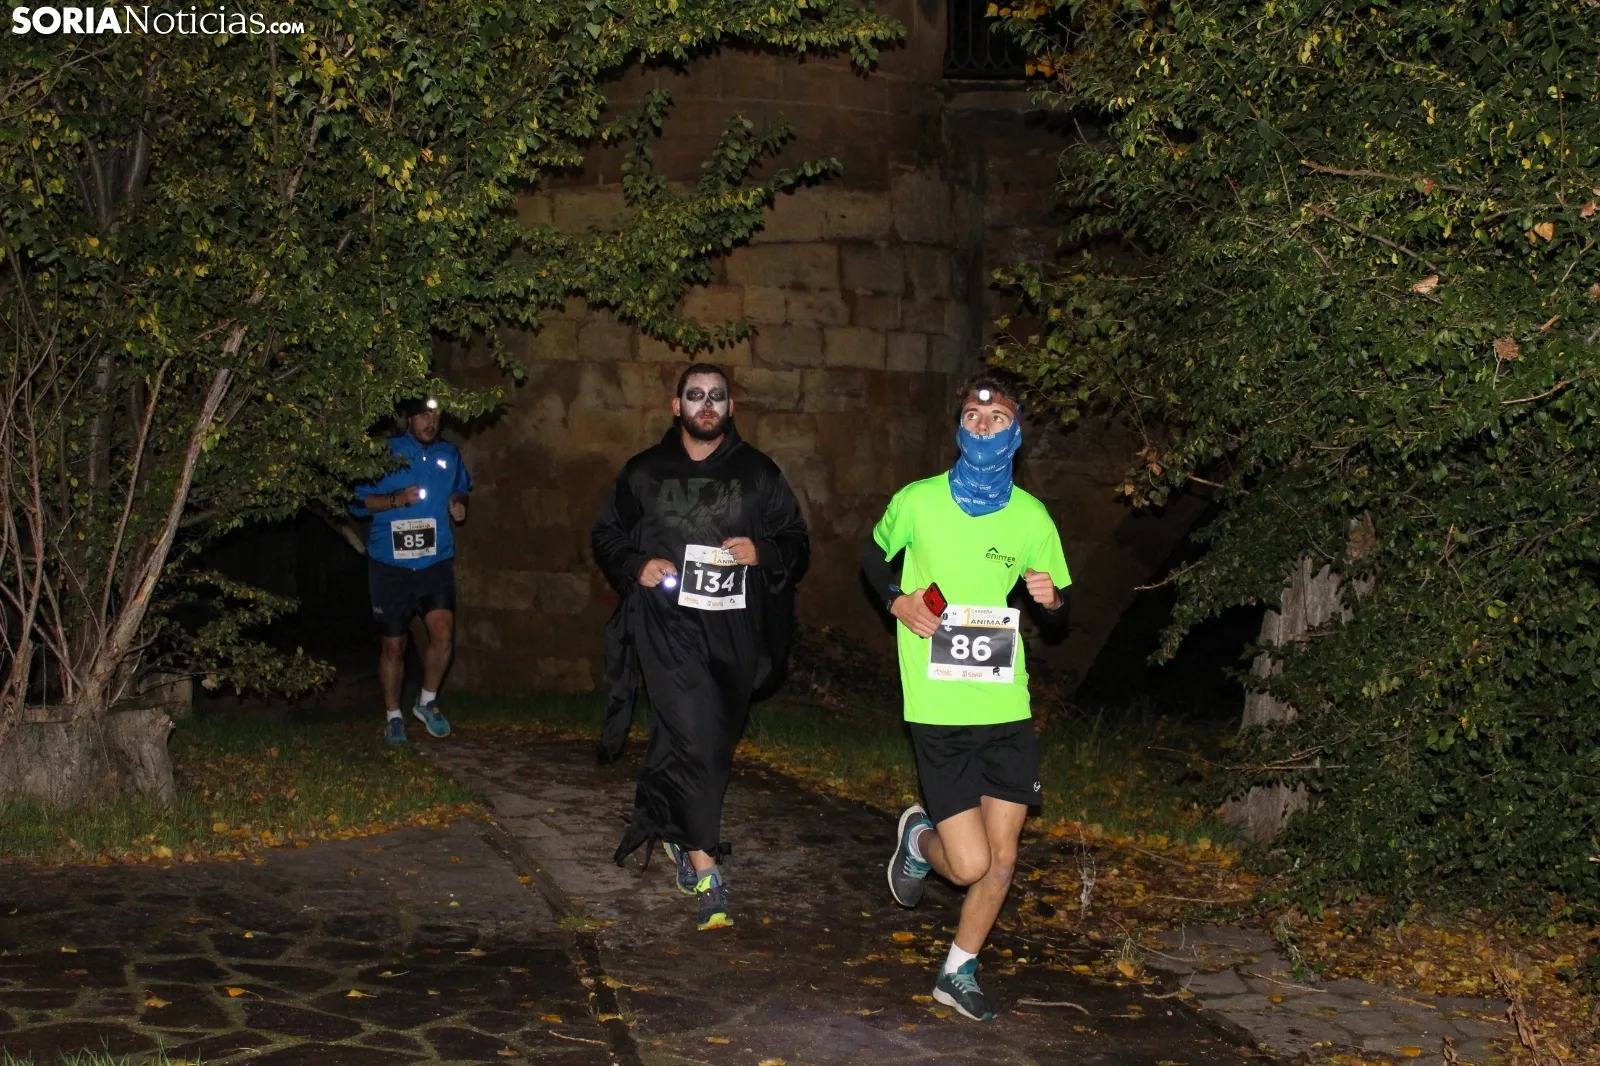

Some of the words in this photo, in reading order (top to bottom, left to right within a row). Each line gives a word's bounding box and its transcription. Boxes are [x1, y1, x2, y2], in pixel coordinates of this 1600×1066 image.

[404, 533, 425, 548] 85
[694, 569, 735, 593] 134
[950, 634, 992, 662] 86
